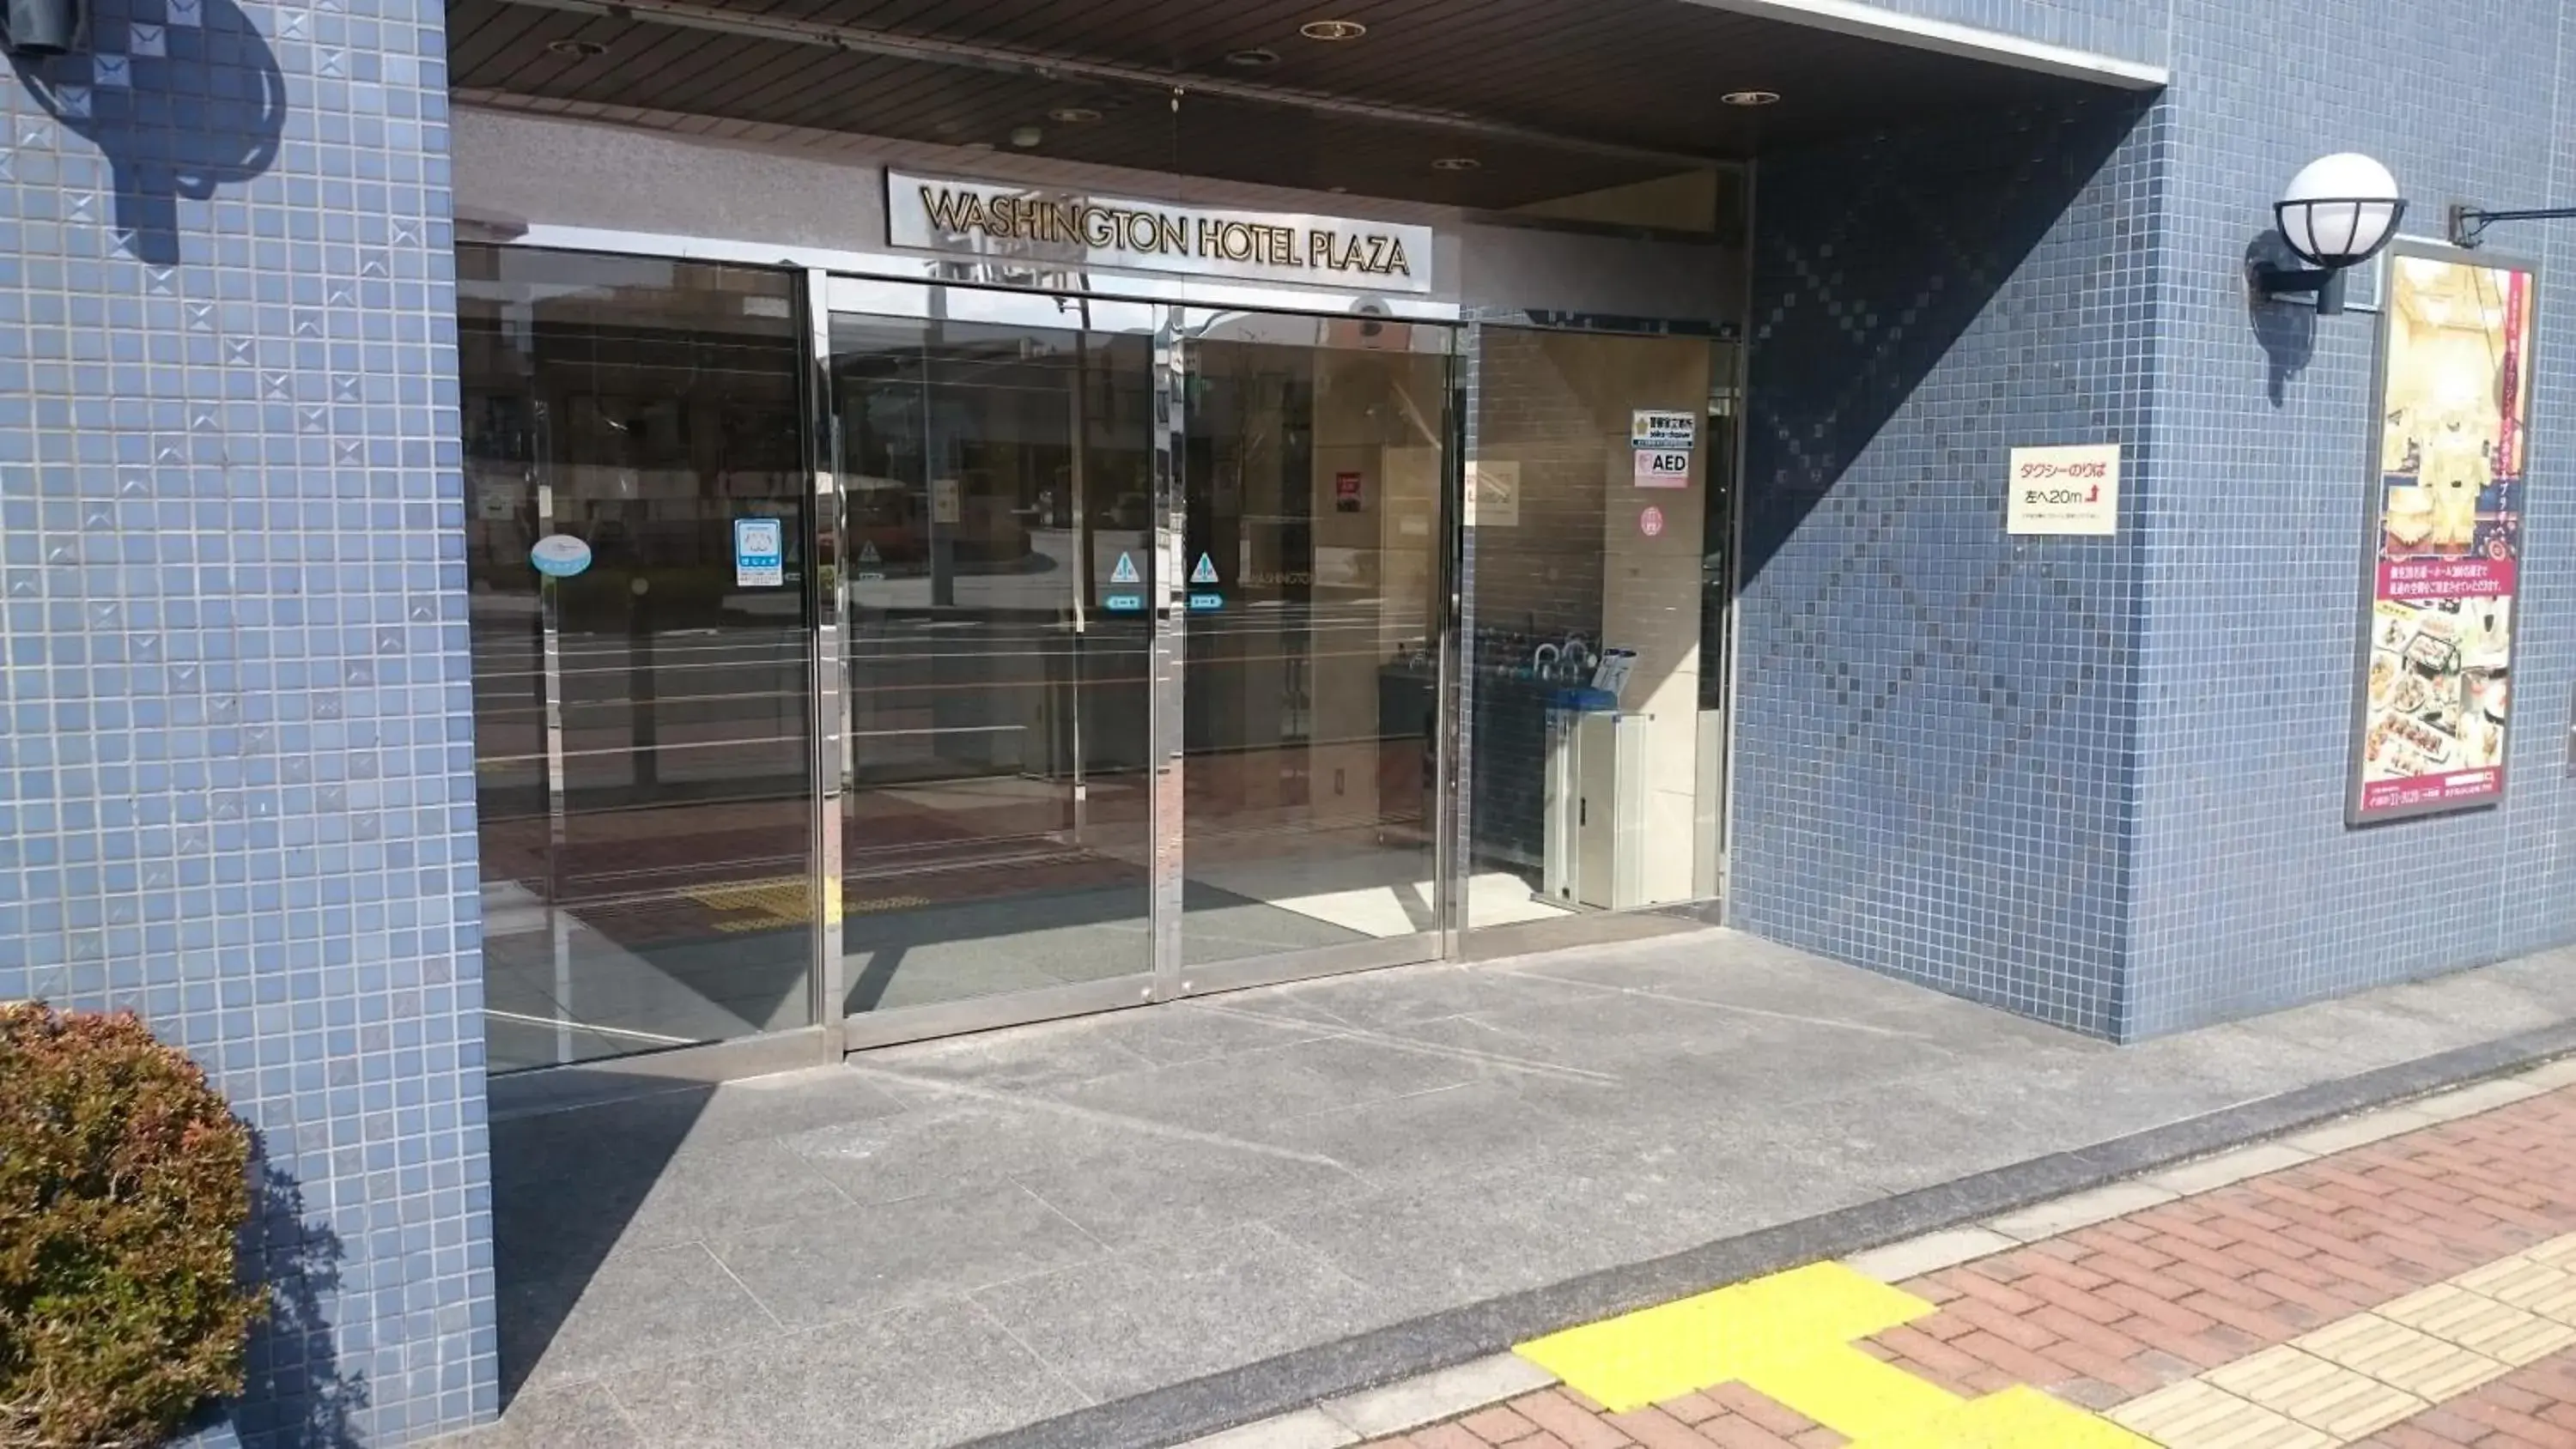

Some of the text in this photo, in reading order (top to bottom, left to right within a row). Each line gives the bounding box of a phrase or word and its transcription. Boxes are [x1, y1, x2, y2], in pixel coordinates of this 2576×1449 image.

[920, 186, 1410, 276] WASHINGTON HOTEL PLAZA
[1652, 454, 1686, 471] AED
[2020, 461, 2106, 478] タクシーのりば
[2025, 489, 2082, 504] 左へ20m
